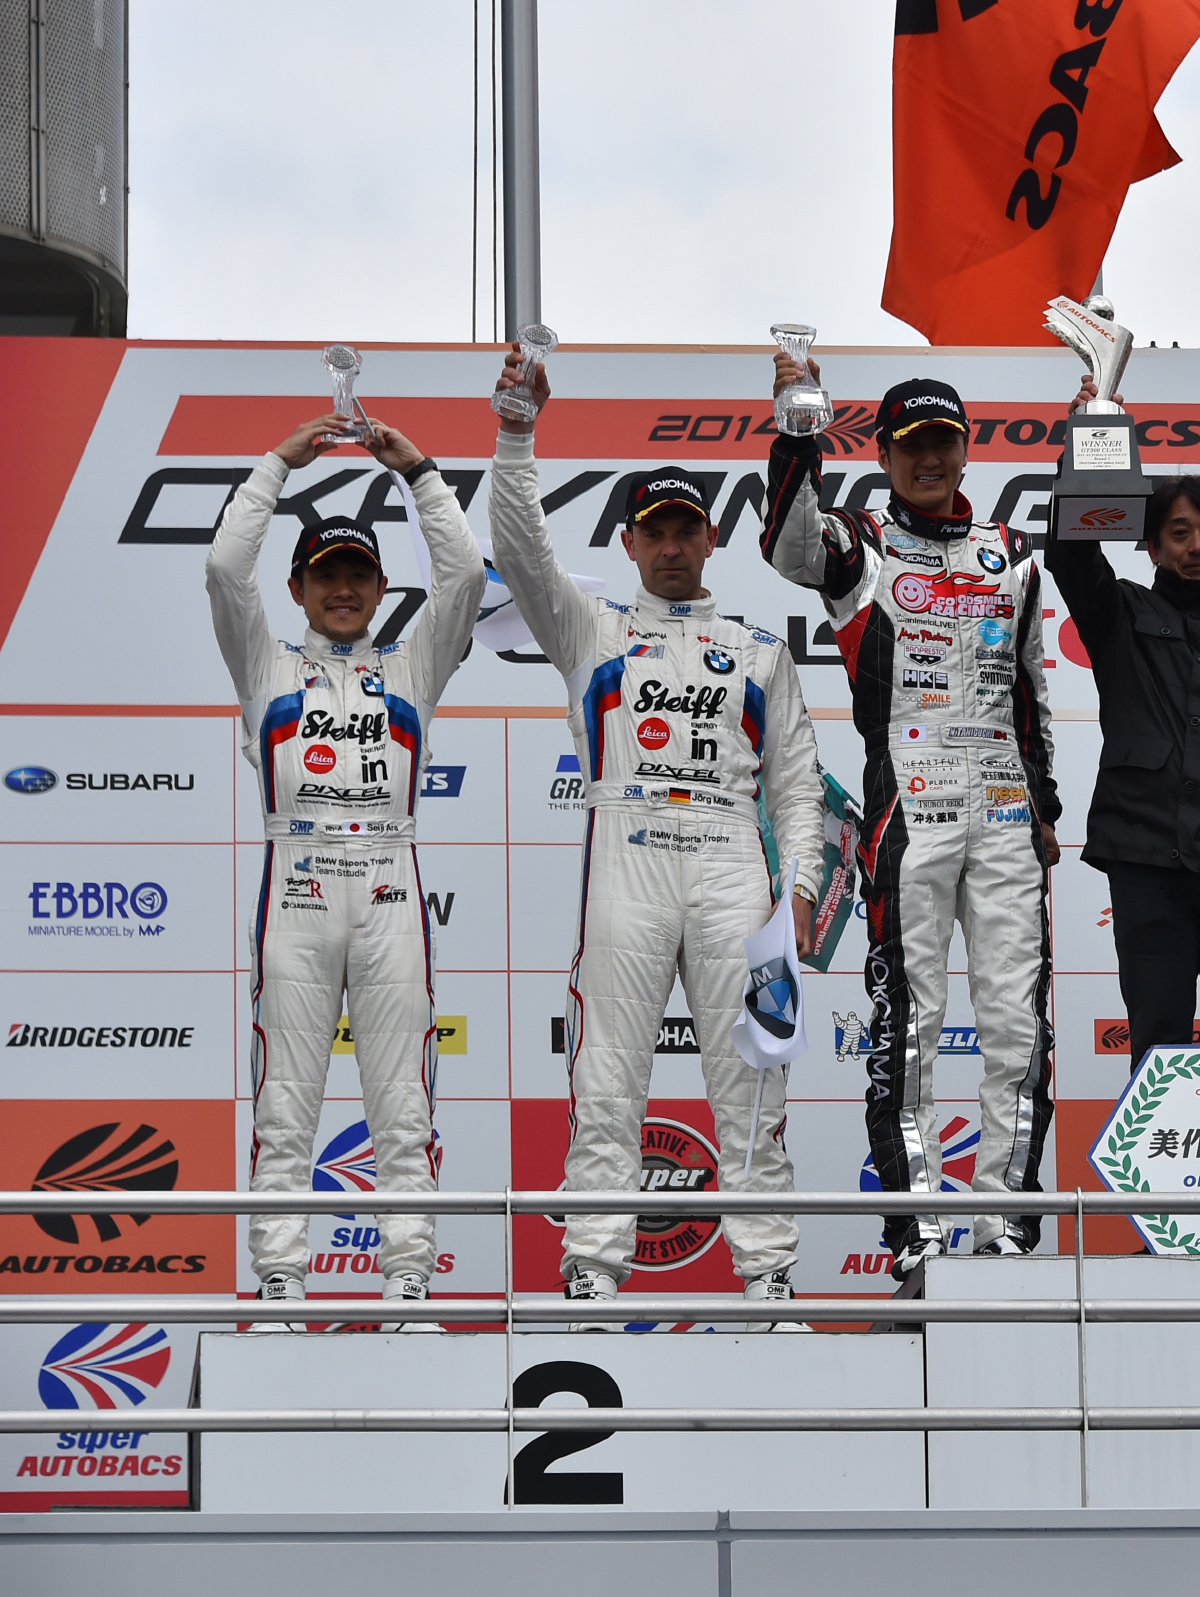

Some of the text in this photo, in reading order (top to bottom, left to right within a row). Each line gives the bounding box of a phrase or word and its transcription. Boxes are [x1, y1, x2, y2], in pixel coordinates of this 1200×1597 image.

[1067, 307, 1117, 344] AUTOBACS
[903, 395, 960, 414] YOKOHAMA
[647, 479, 702, 502] YOKOHAMA
[319, 527, 374, 549] YOKOHAMA
[900, 554, 942, 567] YOKOHAMA
[669, 605, 692, 616] OMP
[929, 603, 996, 619] RACING
[752, 630, 778, 646] OMP
[331, 644, 353, 656] OMP
[905, 644, 946, 656] BANPRESTO
[978, 663, 1013, 673] PETRONAS
[903, 669, 949, 688] HKS
[980, 672, 1013, 686] SYNTIUM
[634, 679, 727, 720] Steiff
[916, 702, 950, 710] COMPANY
[922, 693, 951, 704] SMILE
[301, 709, 388, 742] Steiff
[638, 727, 668, 740] Leica
[690, 730, 718, 761] in
[305, 752, 334, 765] Leica
[360, 755, 388, 784] in
[635, 762, 721, 784] DIXCEL
[66, 773, 195, 791] SUBARU
[297, 783, 391, 801] DIXCEL
[691, 792, 735, 808] Jörg Müller
[289, 821, 314, 835] OMP
[366, 823, 385, 833] Seiji
[386, 824, 399, 832] Ara
[650, 830, 672, 840] BMW
[703, 834, 730, 844] Trophy
[650, 841, 670, 851] Team
[315, 856, 337, 866] BMW
[315, 865, 336, 876] Team
[29, 881, 169, 919] EBBRO
[28, 924, 83, 937] MINIATURE
[85, 925, 122, 937] MODEL
[124, 926, 135, 938] by
[867, 944, 893, 1101] YOKOHAMA
[6, 1024, 195, 1048] BRIDGESTONE
[659, 1224, 704, 1258] STORE
[1, 1254, 206, 1274] AUTOBACS
[267, 1284, 287, 1294] OMP
[403, 1284, 422, 1294] OMP
[576, 1281, 595, 1291] OMP
[767, 1283, 785, 1293] OMP
[503, 1361, 624, 1505] 2
[17, 1455, 183, 1478] AUTOBACS
